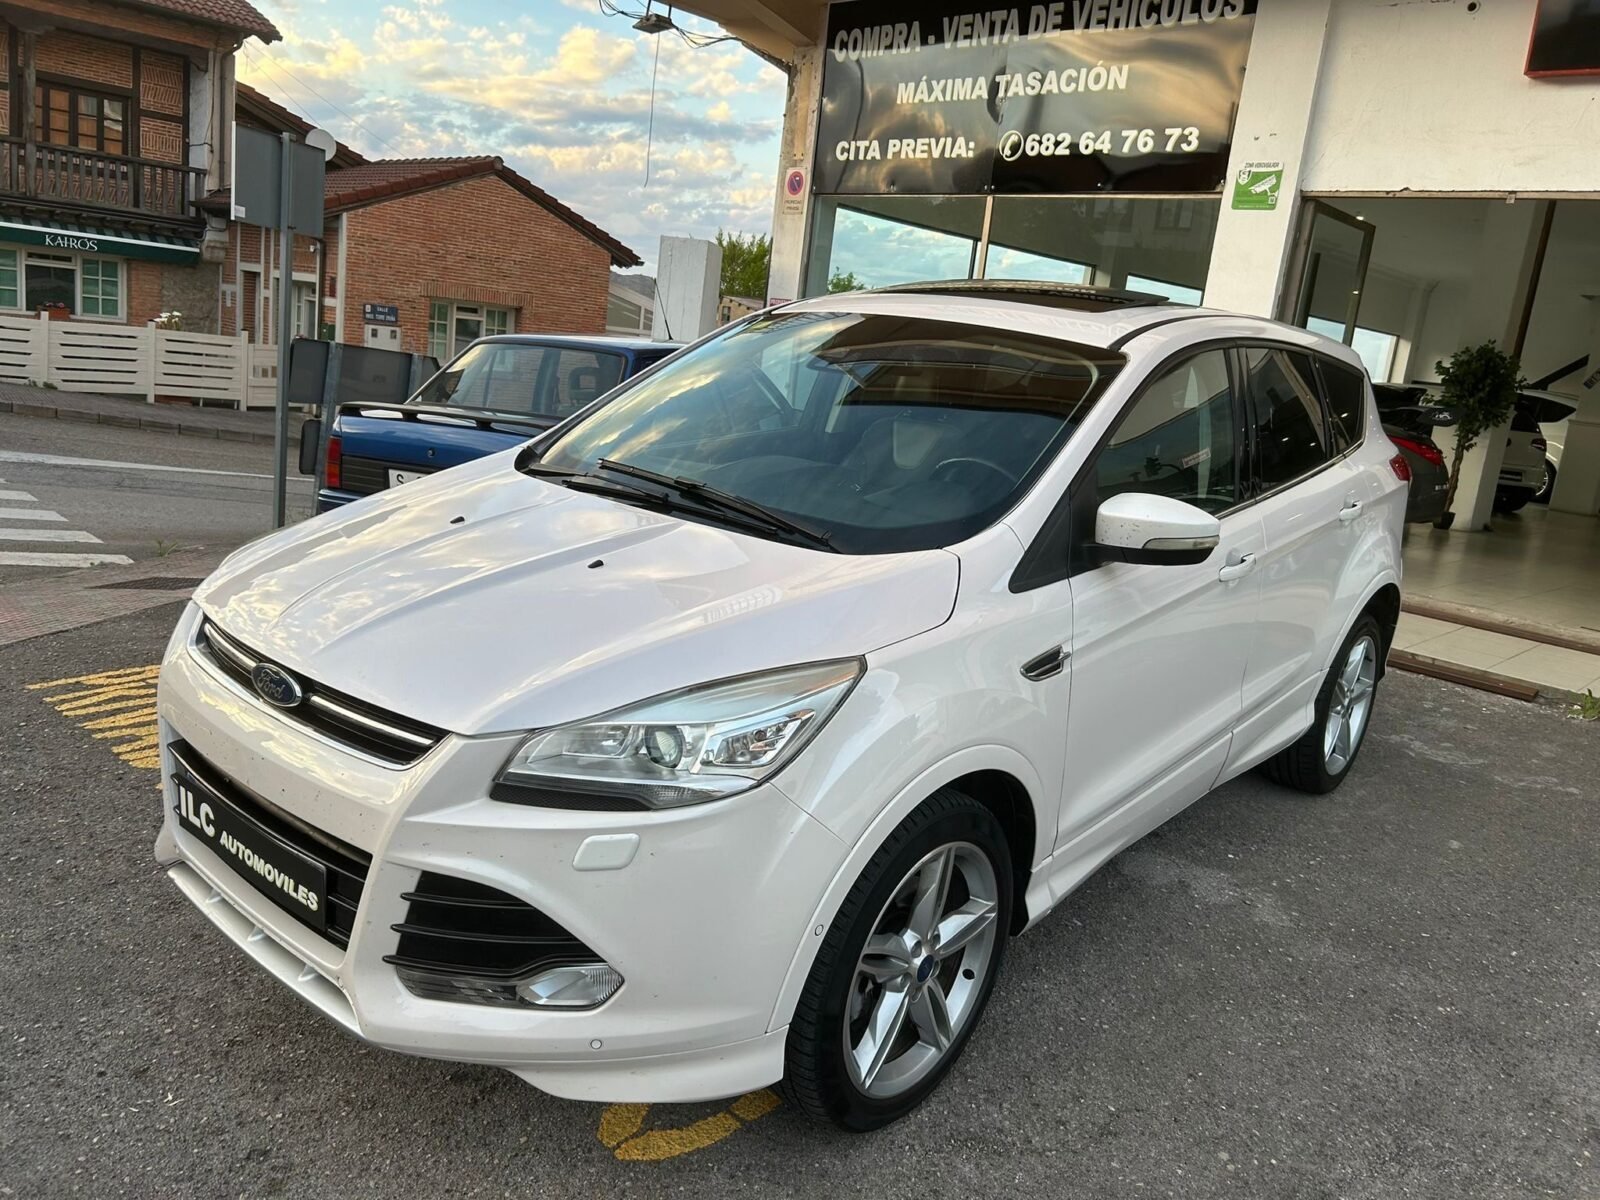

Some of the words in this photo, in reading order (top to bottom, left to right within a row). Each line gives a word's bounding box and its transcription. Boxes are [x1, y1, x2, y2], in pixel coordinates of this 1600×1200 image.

[834, 20, 921, 63] COMPRA
[943, 8, 1020, 50] VENTA
[1027, 2, 1064, 40] DE
[896, 75, 989, 105] MÁXIMA
[995, 60, 1130, 98] TASACIÓN
[835, 140, 881, 161] CITA
[886, 136, 976, 160] PREVIA:
[1025, 132, 1072, 157] 682
[1079, 130, 1113, 155] 64
[1121, 128, 1156, 153] 76
[1164, 126, 1201, 153] 73
[257, 668, 286, 699] Ford
[179, 785, 216, 838] ILC
[219, 830, 319, 912] AUTOMOVILES
